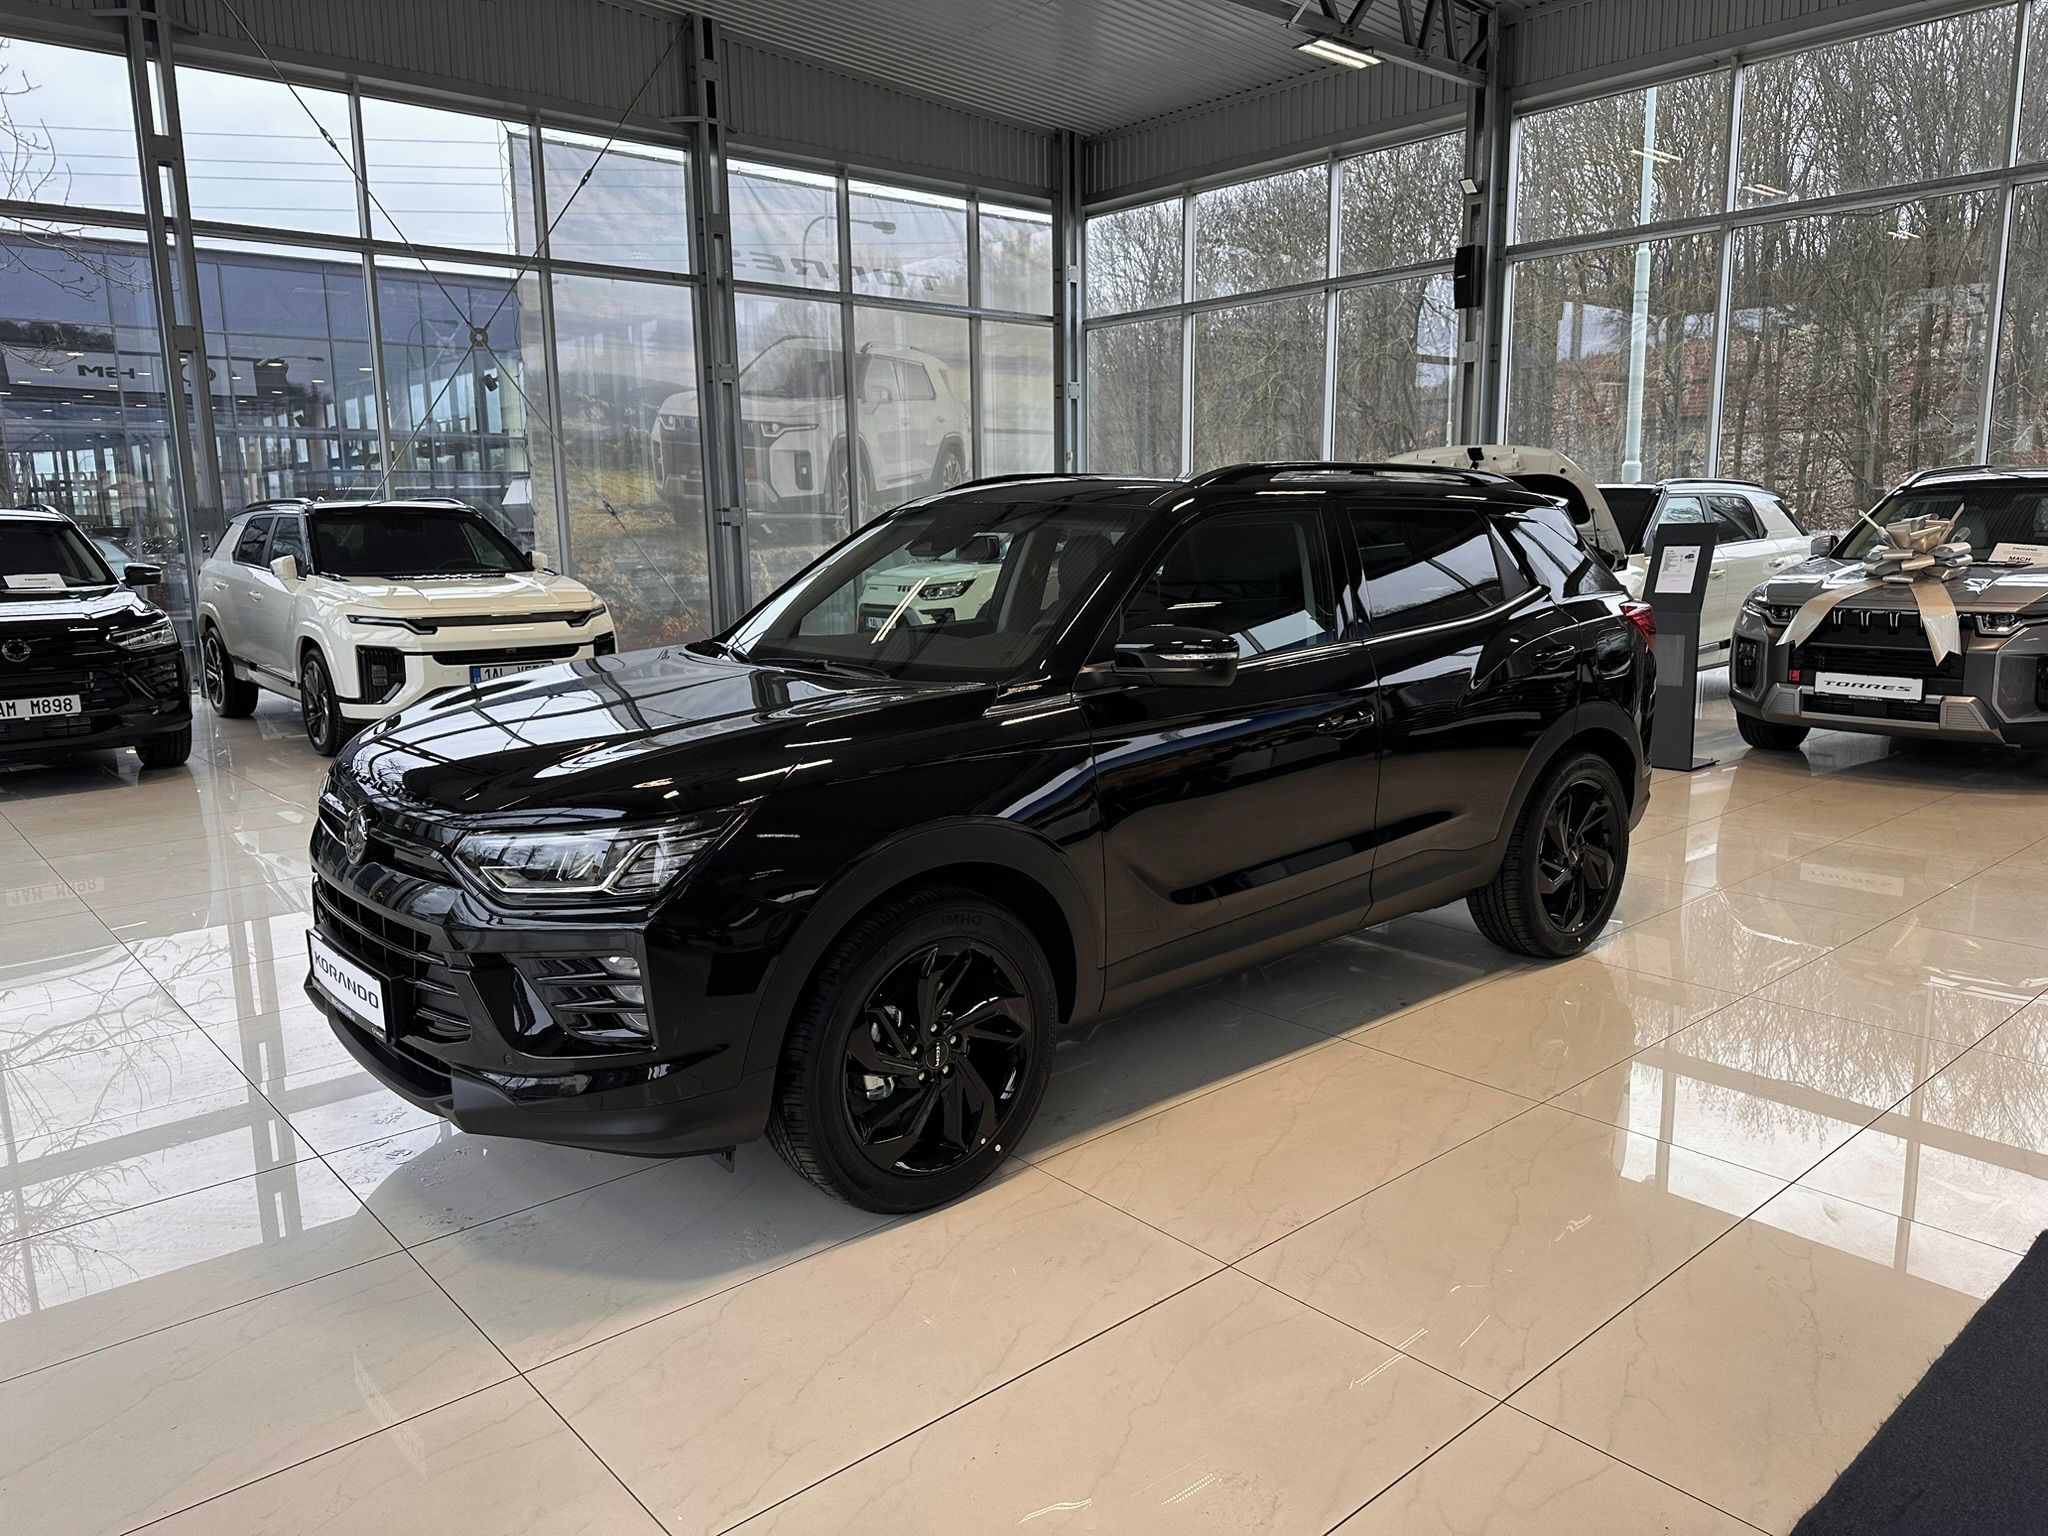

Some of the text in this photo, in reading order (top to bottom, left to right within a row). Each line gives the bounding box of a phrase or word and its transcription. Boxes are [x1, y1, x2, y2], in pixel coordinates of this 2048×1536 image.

[1823, 679, 1913, 692] TORRES
[30, 697, 73, 715] M898
[314, 951, 380, 1009] KORANDO
